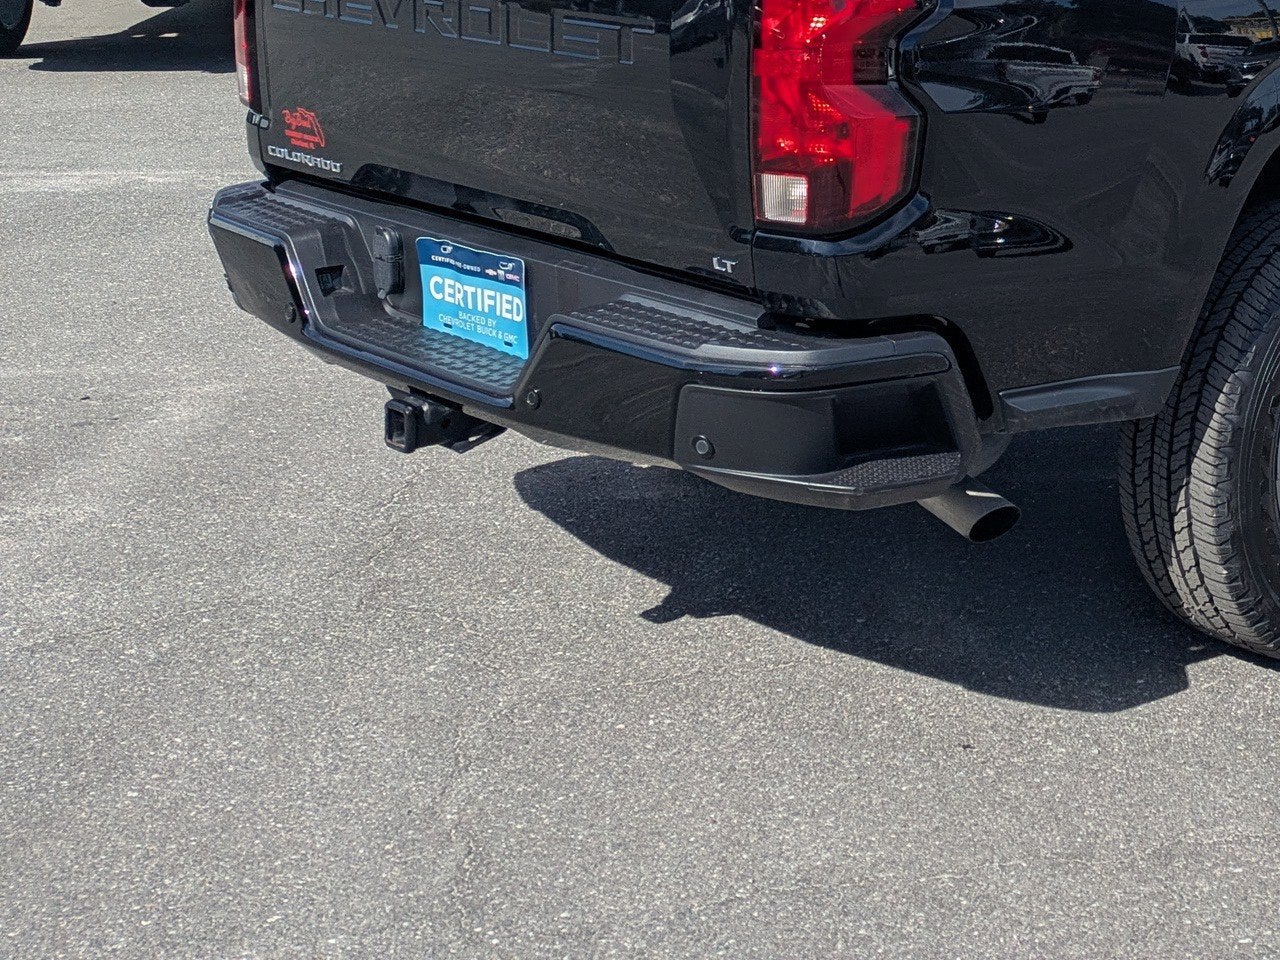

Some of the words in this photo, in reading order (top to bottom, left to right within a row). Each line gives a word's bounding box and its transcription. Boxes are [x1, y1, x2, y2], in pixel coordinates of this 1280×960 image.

[267, 145, 343, 173] COLORADO
[712, 256, 738, 273] LT
[429, 276, 523, 322] CERTIFIED
[438, 314, 475, 331] CHEVROLET
[477, 324, 497, 337] BUICK
[503, 332, 519, 344] GMC
[459, 311, 486, 325] BACKED
[487, 319, 497, 327] BY
